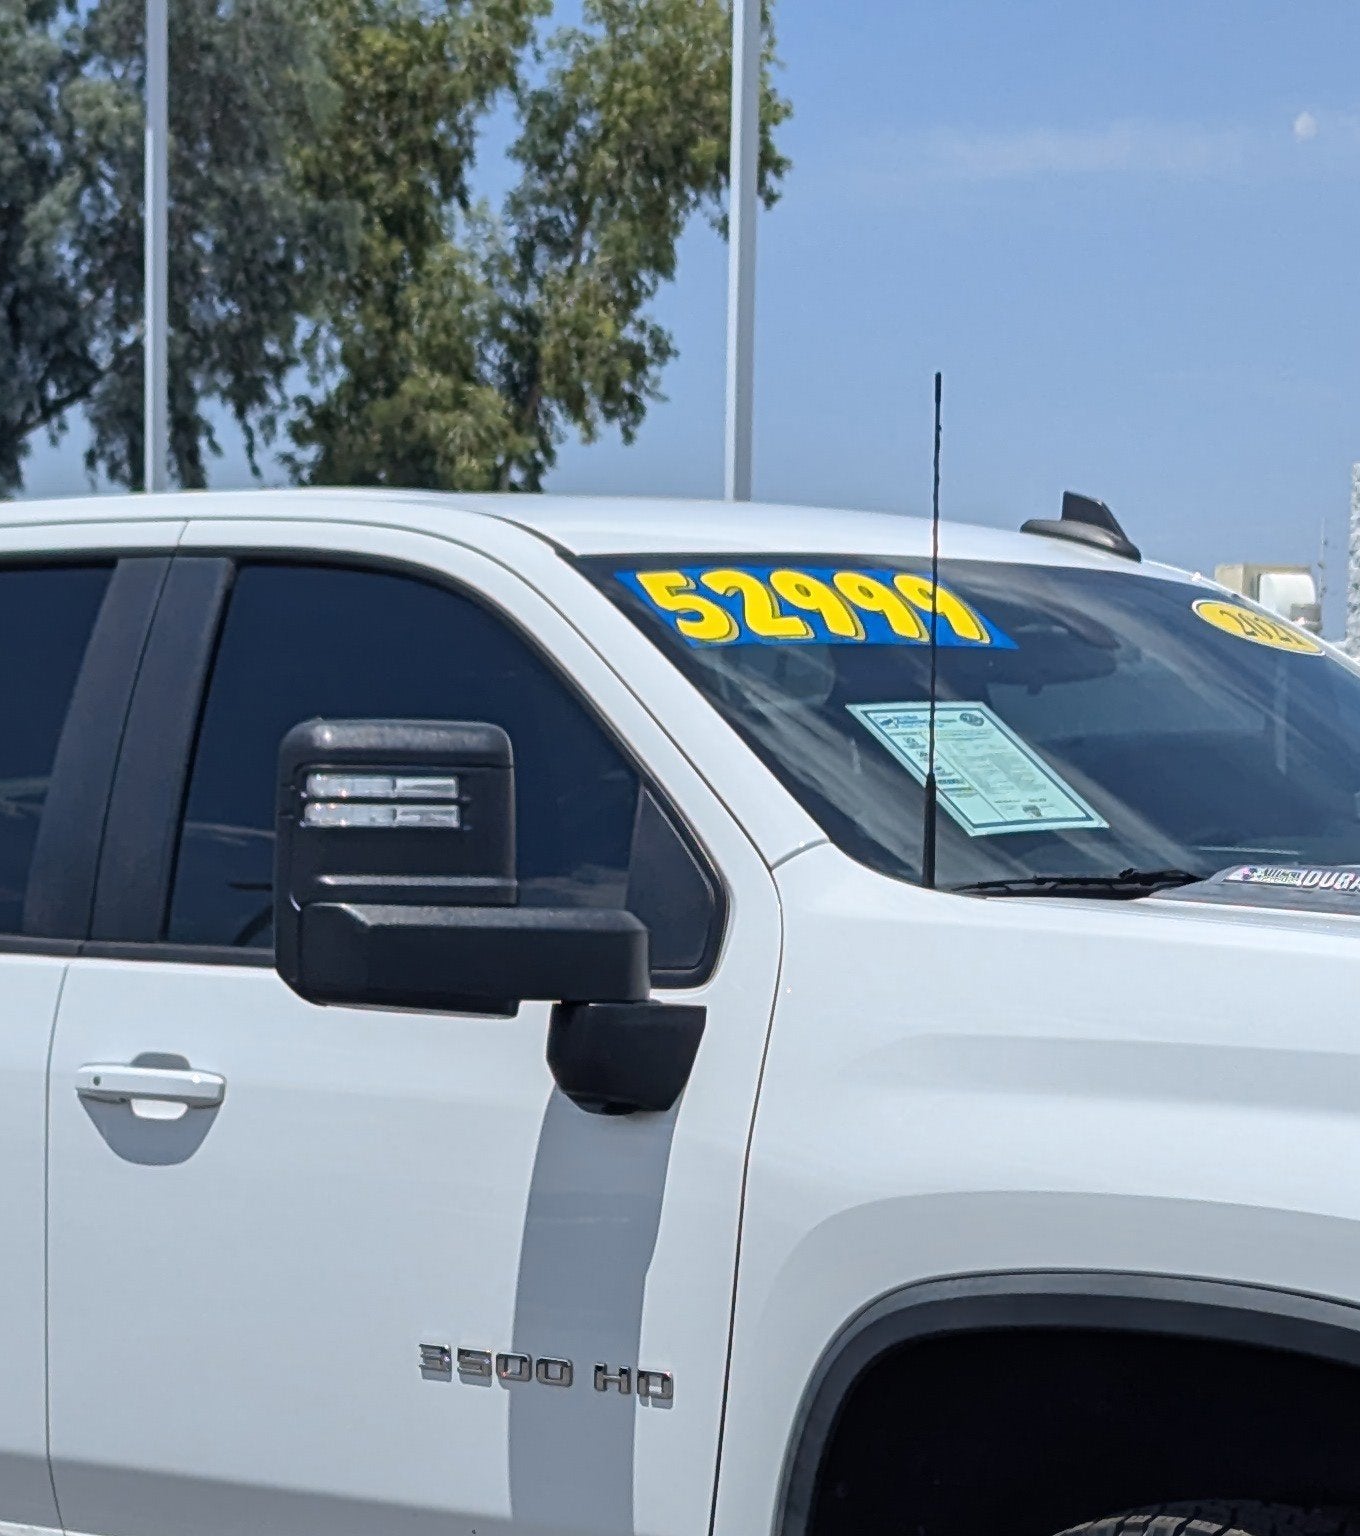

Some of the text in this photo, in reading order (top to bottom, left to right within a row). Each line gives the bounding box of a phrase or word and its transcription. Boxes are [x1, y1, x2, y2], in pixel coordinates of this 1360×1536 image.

[636, 569, 991, 643] 52999
[419, 1343, 674, 1401] 3500 HD
